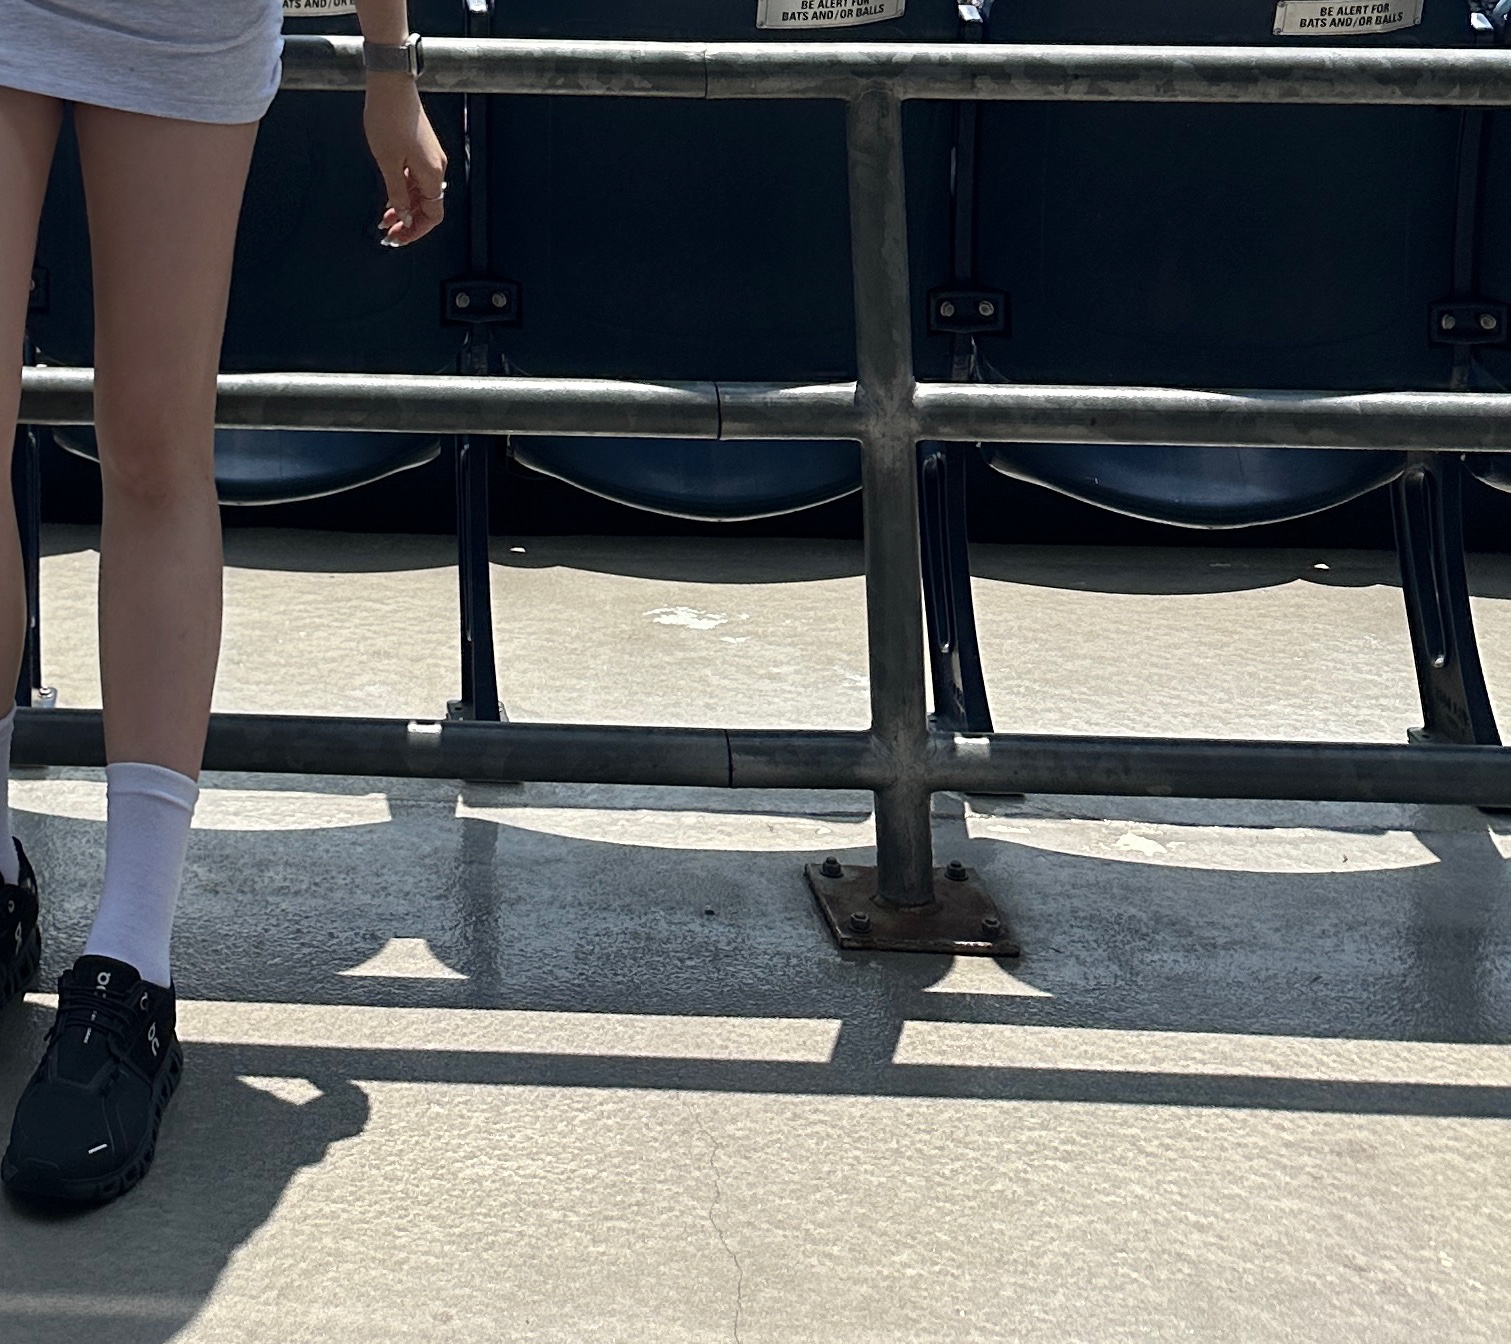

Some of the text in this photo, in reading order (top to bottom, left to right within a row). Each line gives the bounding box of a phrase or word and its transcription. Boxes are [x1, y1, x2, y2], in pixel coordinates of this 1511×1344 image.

[282, 0, 302, 9] ATS
[801, 0, 815, 10] BE
[1319, 2, 1391, 17] BE ALERT FOR
[781, 4, 885, 22] BATS AND/OR BALLS
[1299, 12, 1403, 29] BATS AND/OR BALLS
